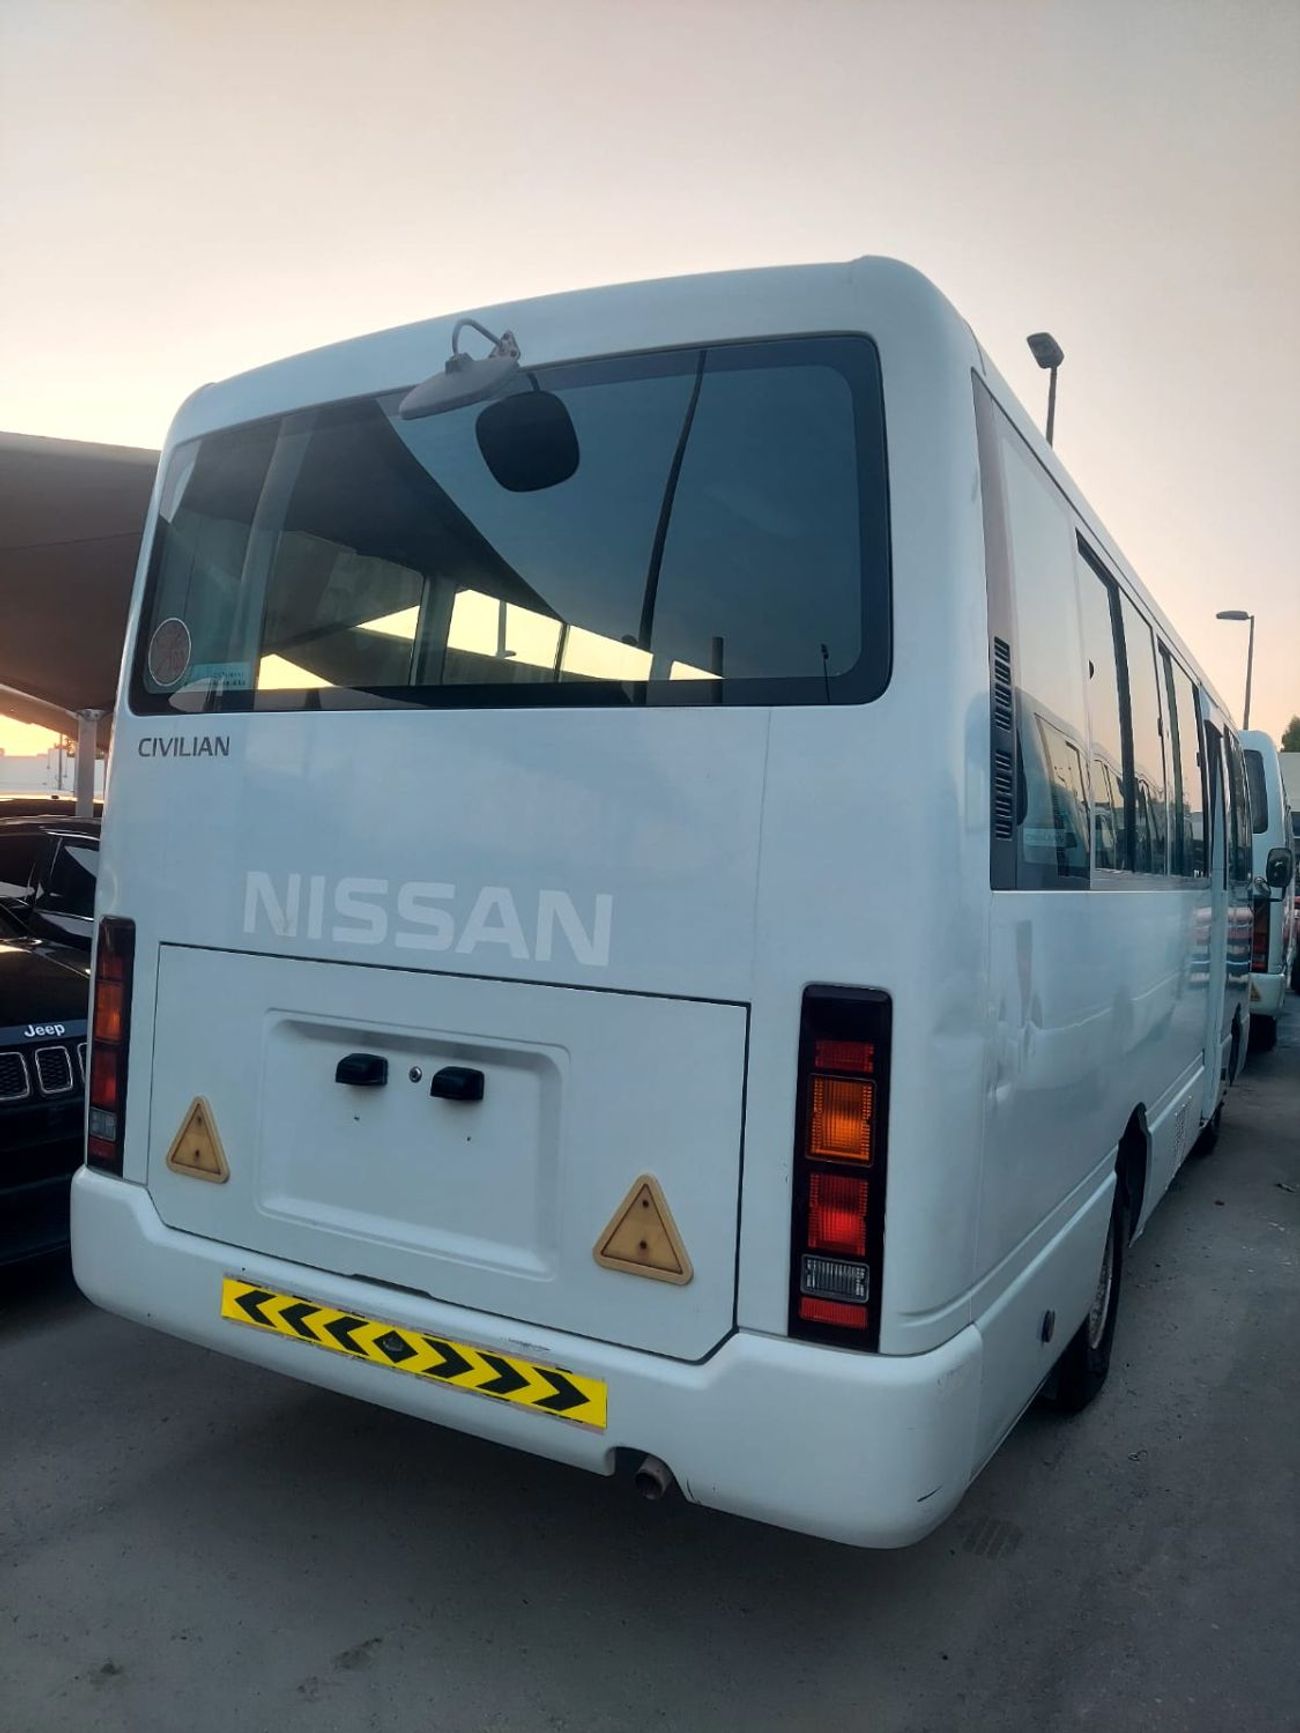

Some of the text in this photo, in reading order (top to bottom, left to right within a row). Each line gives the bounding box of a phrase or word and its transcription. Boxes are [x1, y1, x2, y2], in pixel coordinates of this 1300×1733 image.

[138, 736, 230, 758] CIVILIAN
[243, 871, 613, 967] NISSAN
[24, 1024, 65, 1037] Jeep
